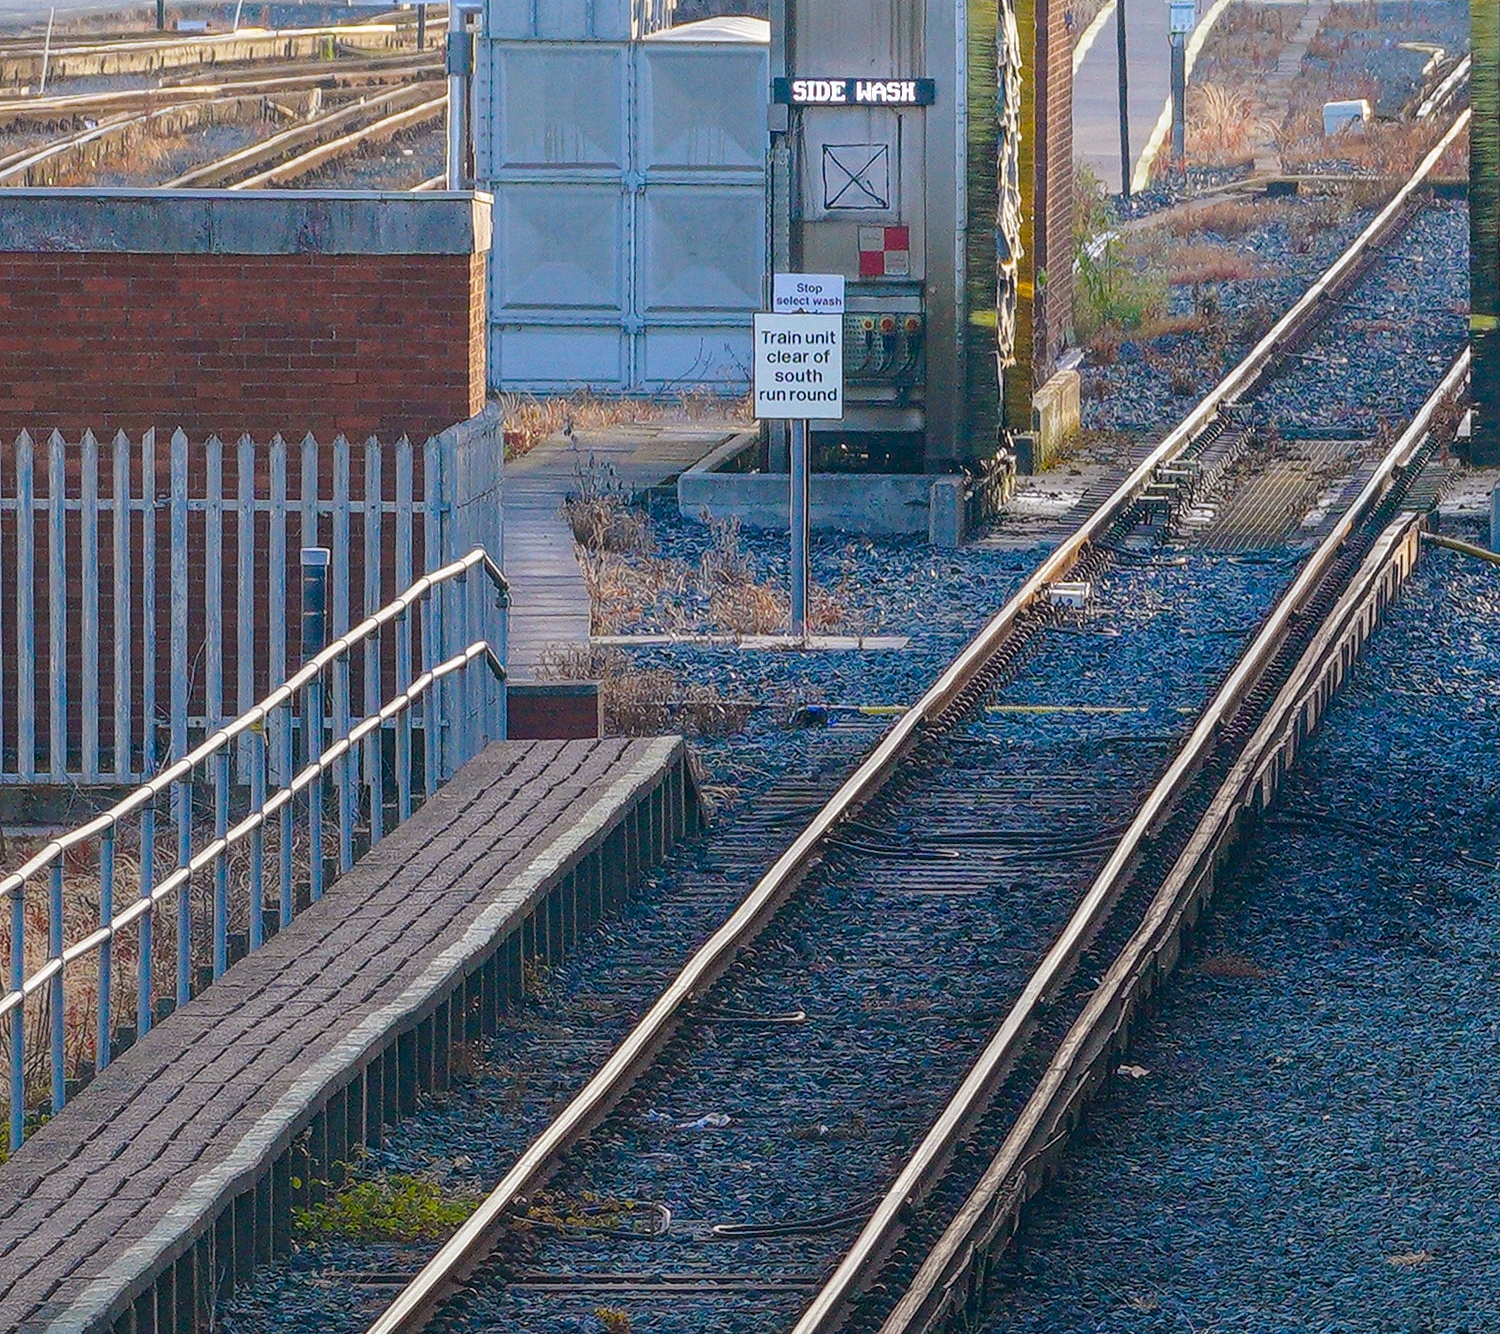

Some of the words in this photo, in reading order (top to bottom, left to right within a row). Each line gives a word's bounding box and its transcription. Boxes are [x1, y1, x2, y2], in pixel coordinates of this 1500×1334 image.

[793, 81, 847, 101] SIDE
[855, 82, 916, 101] WASH
[796, 282, 823, 295] Stop
[776, 296, 809, 306] select
[812, 296, 842, 307] wash
[761, 330, 801, 344] Train
[805, 330, 836, 344] unit
[766, 350, 809, 364] clear
[813, 349, 830, 364] of
[775, 369, 823, 383] south
[760, 388, 786, 401] run
[789, 387, 837, 402] round
